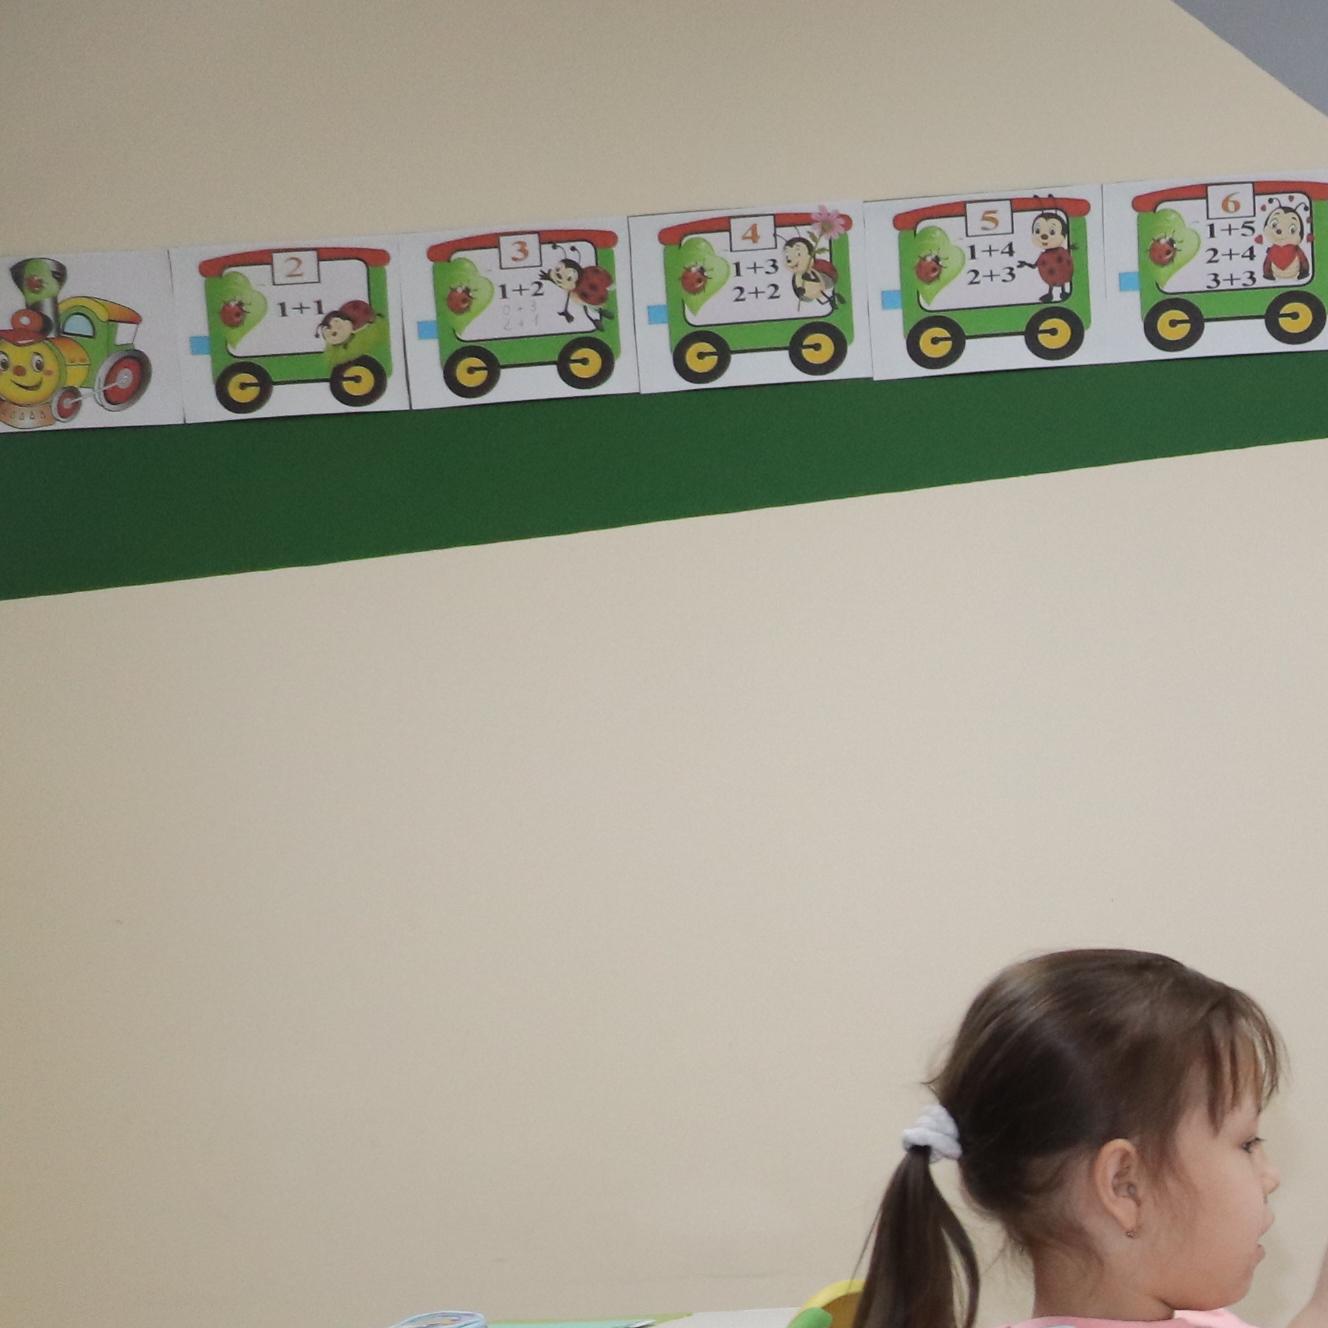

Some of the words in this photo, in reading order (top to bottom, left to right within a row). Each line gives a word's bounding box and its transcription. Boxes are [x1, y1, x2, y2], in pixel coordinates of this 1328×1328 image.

[1222, 192, 1241, 214] 6
[980, 209, 999, 231] 5
[1207, 221, 1256, 238] 1+5
[742, 223, 760, 244] 4
[511, 240, 529, 262] 3
[968, 241, 1015, 260] 1+4
[1205, 245, 1257, 264] 2+4
[284, 256, 304, 278] 2
[733, 258, 779, 277] 1+3
[967, 266, 1016, 285] 2+3
[1206, 270, 1257, 289] 3+3
[499, 281, 544, 299] 1+2
[733, 283, 781, 302] 2+2
[277, 299, 324, 318] 1+1
